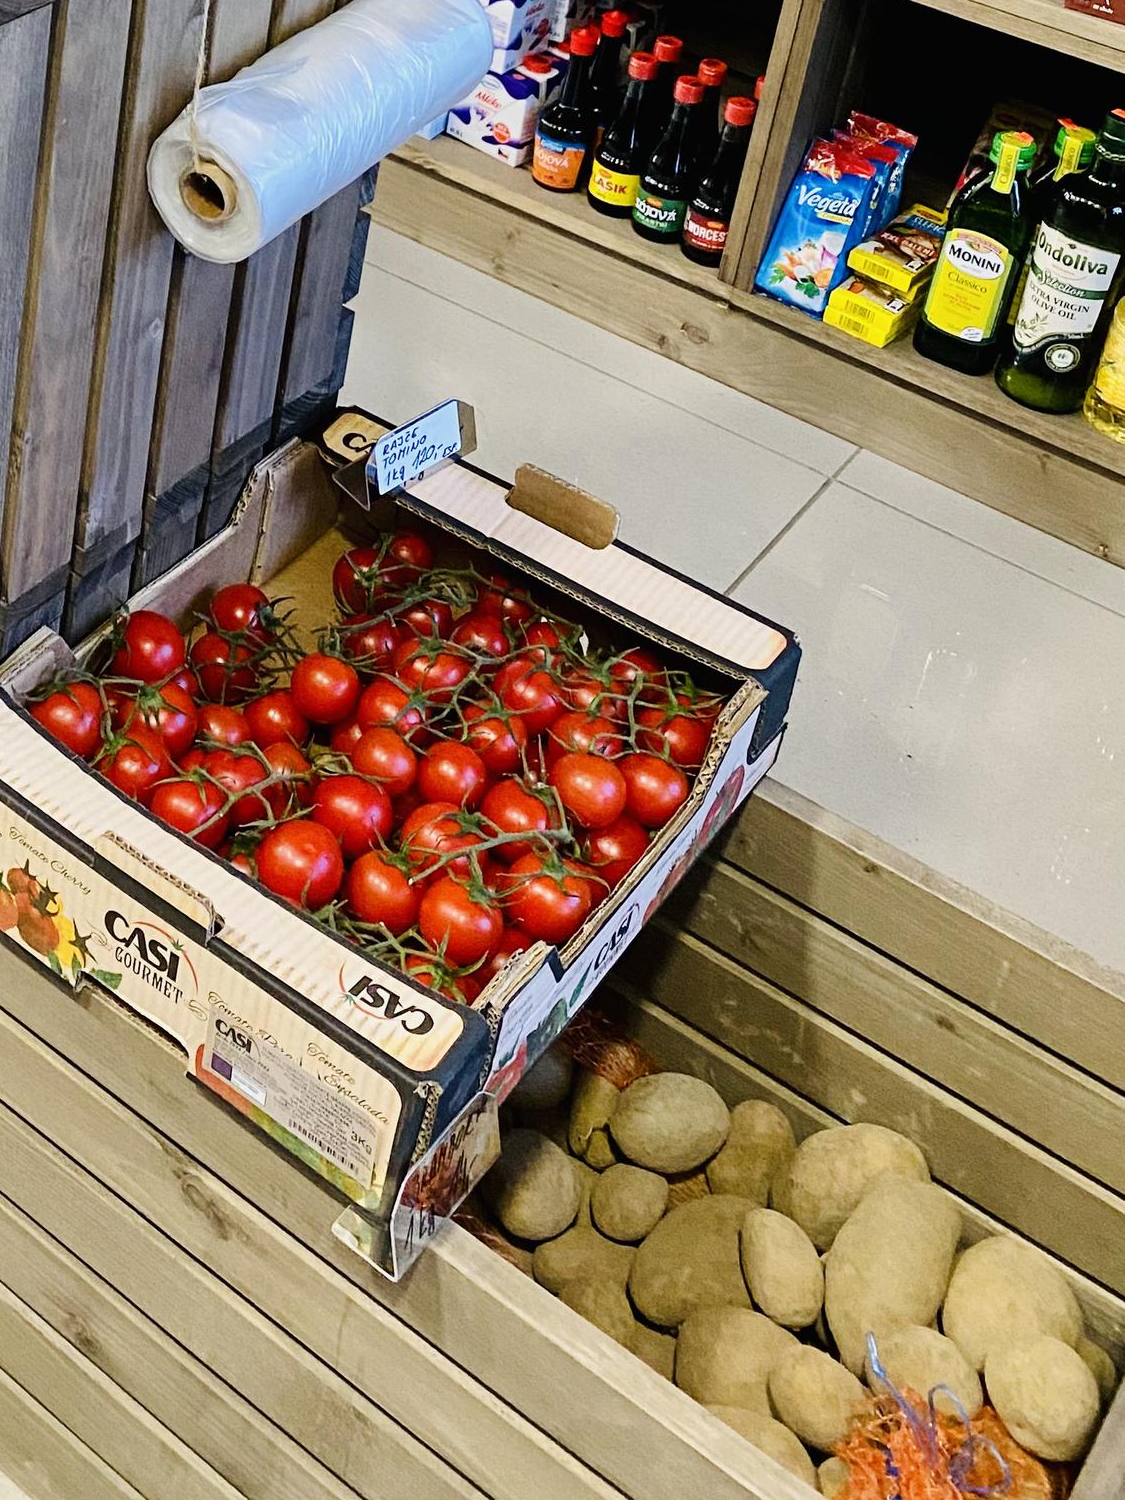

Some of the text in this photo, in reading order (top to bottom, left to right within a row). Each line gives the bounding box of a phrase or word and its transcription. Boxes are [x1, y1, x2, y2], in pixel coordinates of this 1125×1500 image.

[592, 174, 628, 195] LASIK
[797, 185, 860, 217] Vegeta
[880, 231, 900, 244] XXL
[1038, 231, 1109, 276] Ondoliva
[948, 243, 1002, 275] MONINI
[947, 271, 988, 294] Classico
[1029, 281, 1091, 314] EXTRA VIRGIN
[1038, 269, 1087, 298] Selection
[1031, 294, 1077, 321] OLIVE OIL
[382, 426, 419, 457] RAJČE
[382, 434, 427, 469] TOMINO
[386, 464, 406, 487] 1kg
[412, 442, 444, 470] 120,-
[9, 826, 50, 864] Tomate
[50, 859, 93, 896] Cherry
[104, 910, 181, 983] CASI
[593, 910, 634, 972] CASI
[114, 946, 184, 1005] GOURMET
[207, 991, 254, 1033] Tomate
[350, 974, 435, 1036] CASI
[214, 1018, 253, 1054] CASI
[306, 1042, 357, 1086] Tomate
[349, 1130, 373, 1155] 3Kg
